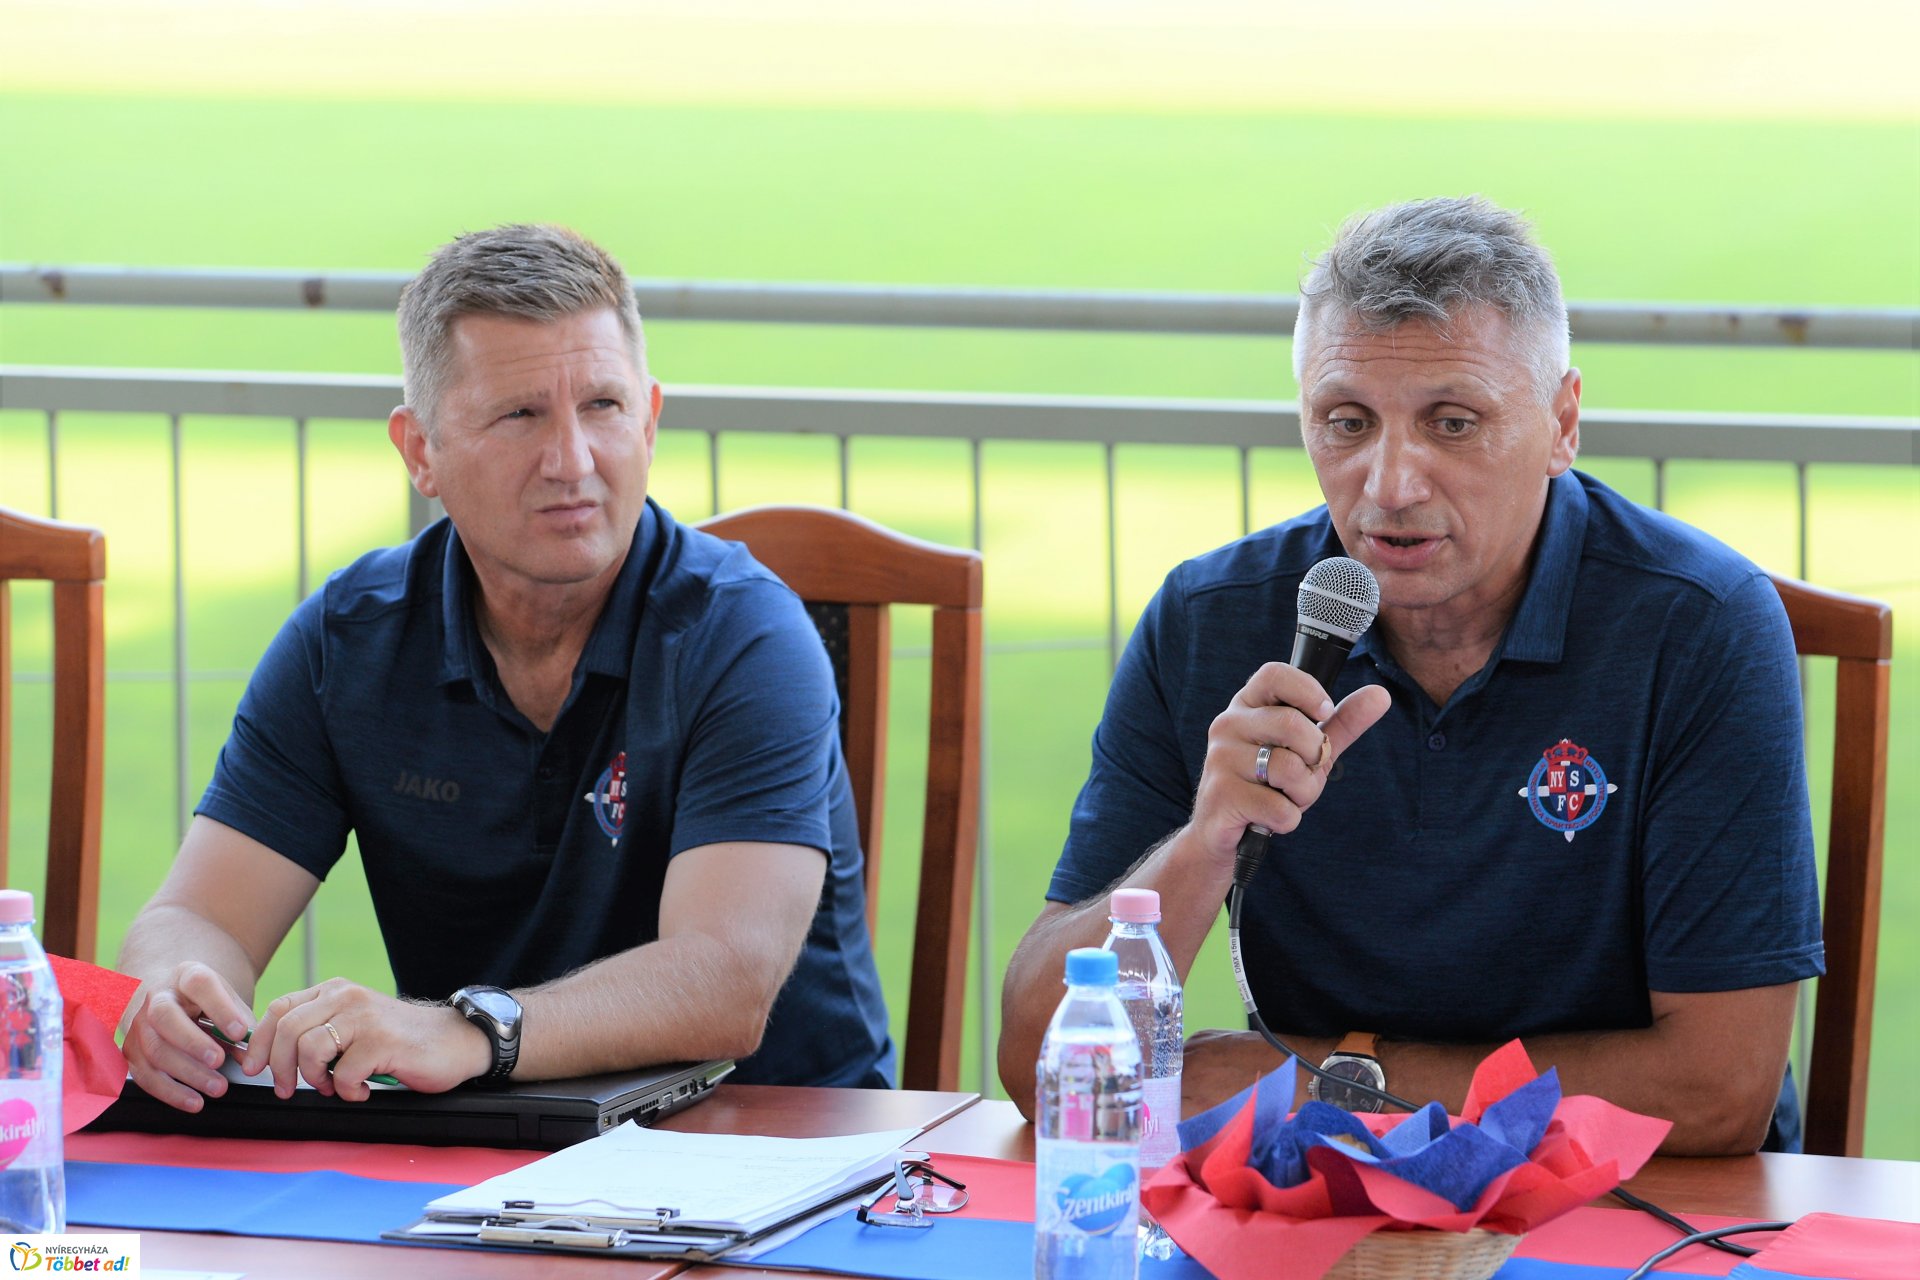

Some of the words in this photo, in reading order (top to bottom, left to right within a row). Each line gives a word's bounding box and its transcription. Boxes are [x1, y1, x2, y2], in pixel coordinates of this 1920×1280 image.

[393, 770, 460, 802] JAKO
[1550, 771, 1564, 788] NY
[1570, 771, 1579, 787] S
[1557, 794, 1567, 811] F
[1569, 794, 1579, 811] C
[1233, 956, 1241, 973] DMX
